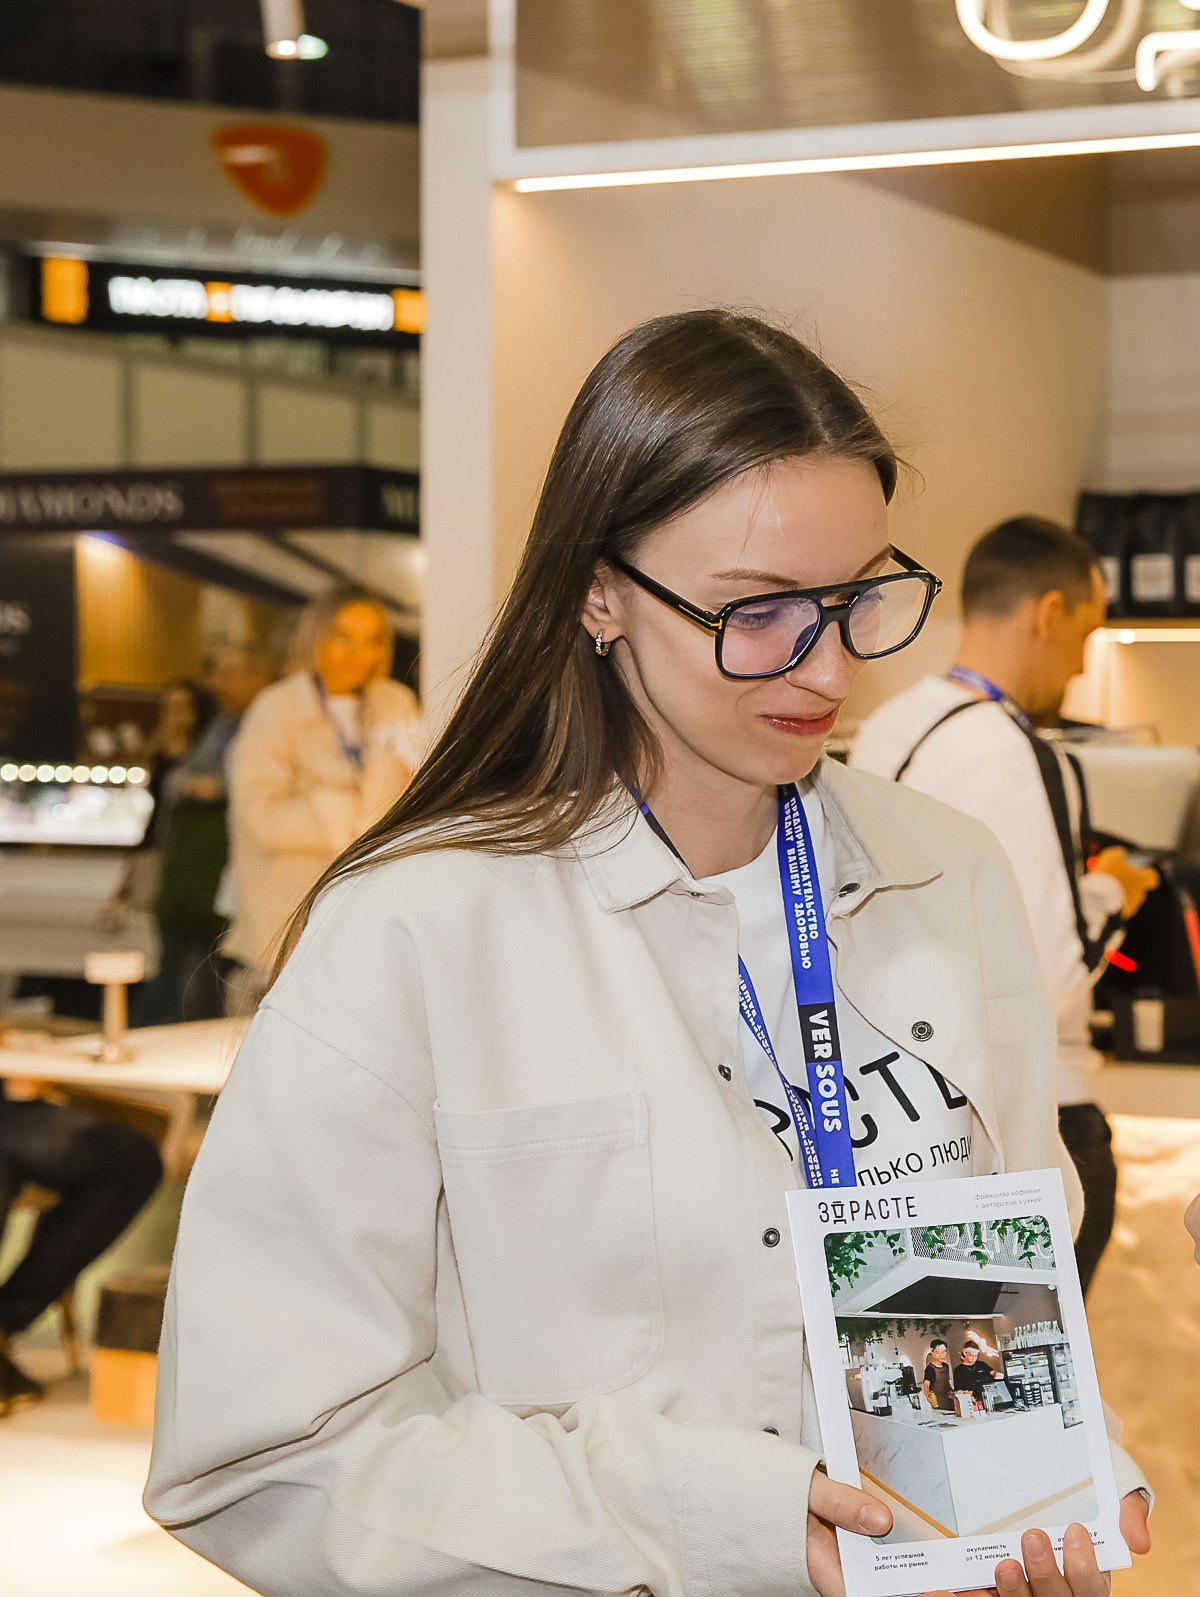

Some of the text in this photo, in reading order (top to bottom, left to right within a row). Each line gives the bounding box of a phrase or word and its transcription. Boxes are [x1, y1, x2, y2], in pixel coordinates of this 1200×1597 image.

[790, 797, 819, 940] ПРЕДПРИНИМАТЕЛЬСТВО
[784, 802, 812, 969] ВРЕДИТ ВАШЕМУ ЗДОРОВЬЮ
[830, 1168, 839, 1185] НЕ
[975, 1188, 1041, 1201] франшиза кофейни
[982, 1201, 1017, 1209] авторской
[1019, 1196, 1043, 1206] кухней
[966, 1544, 1007, 1553] окупаемость
[894, 1551, 925, 1561] успешной
[985, 1552, 1010, 1560] месяцев
